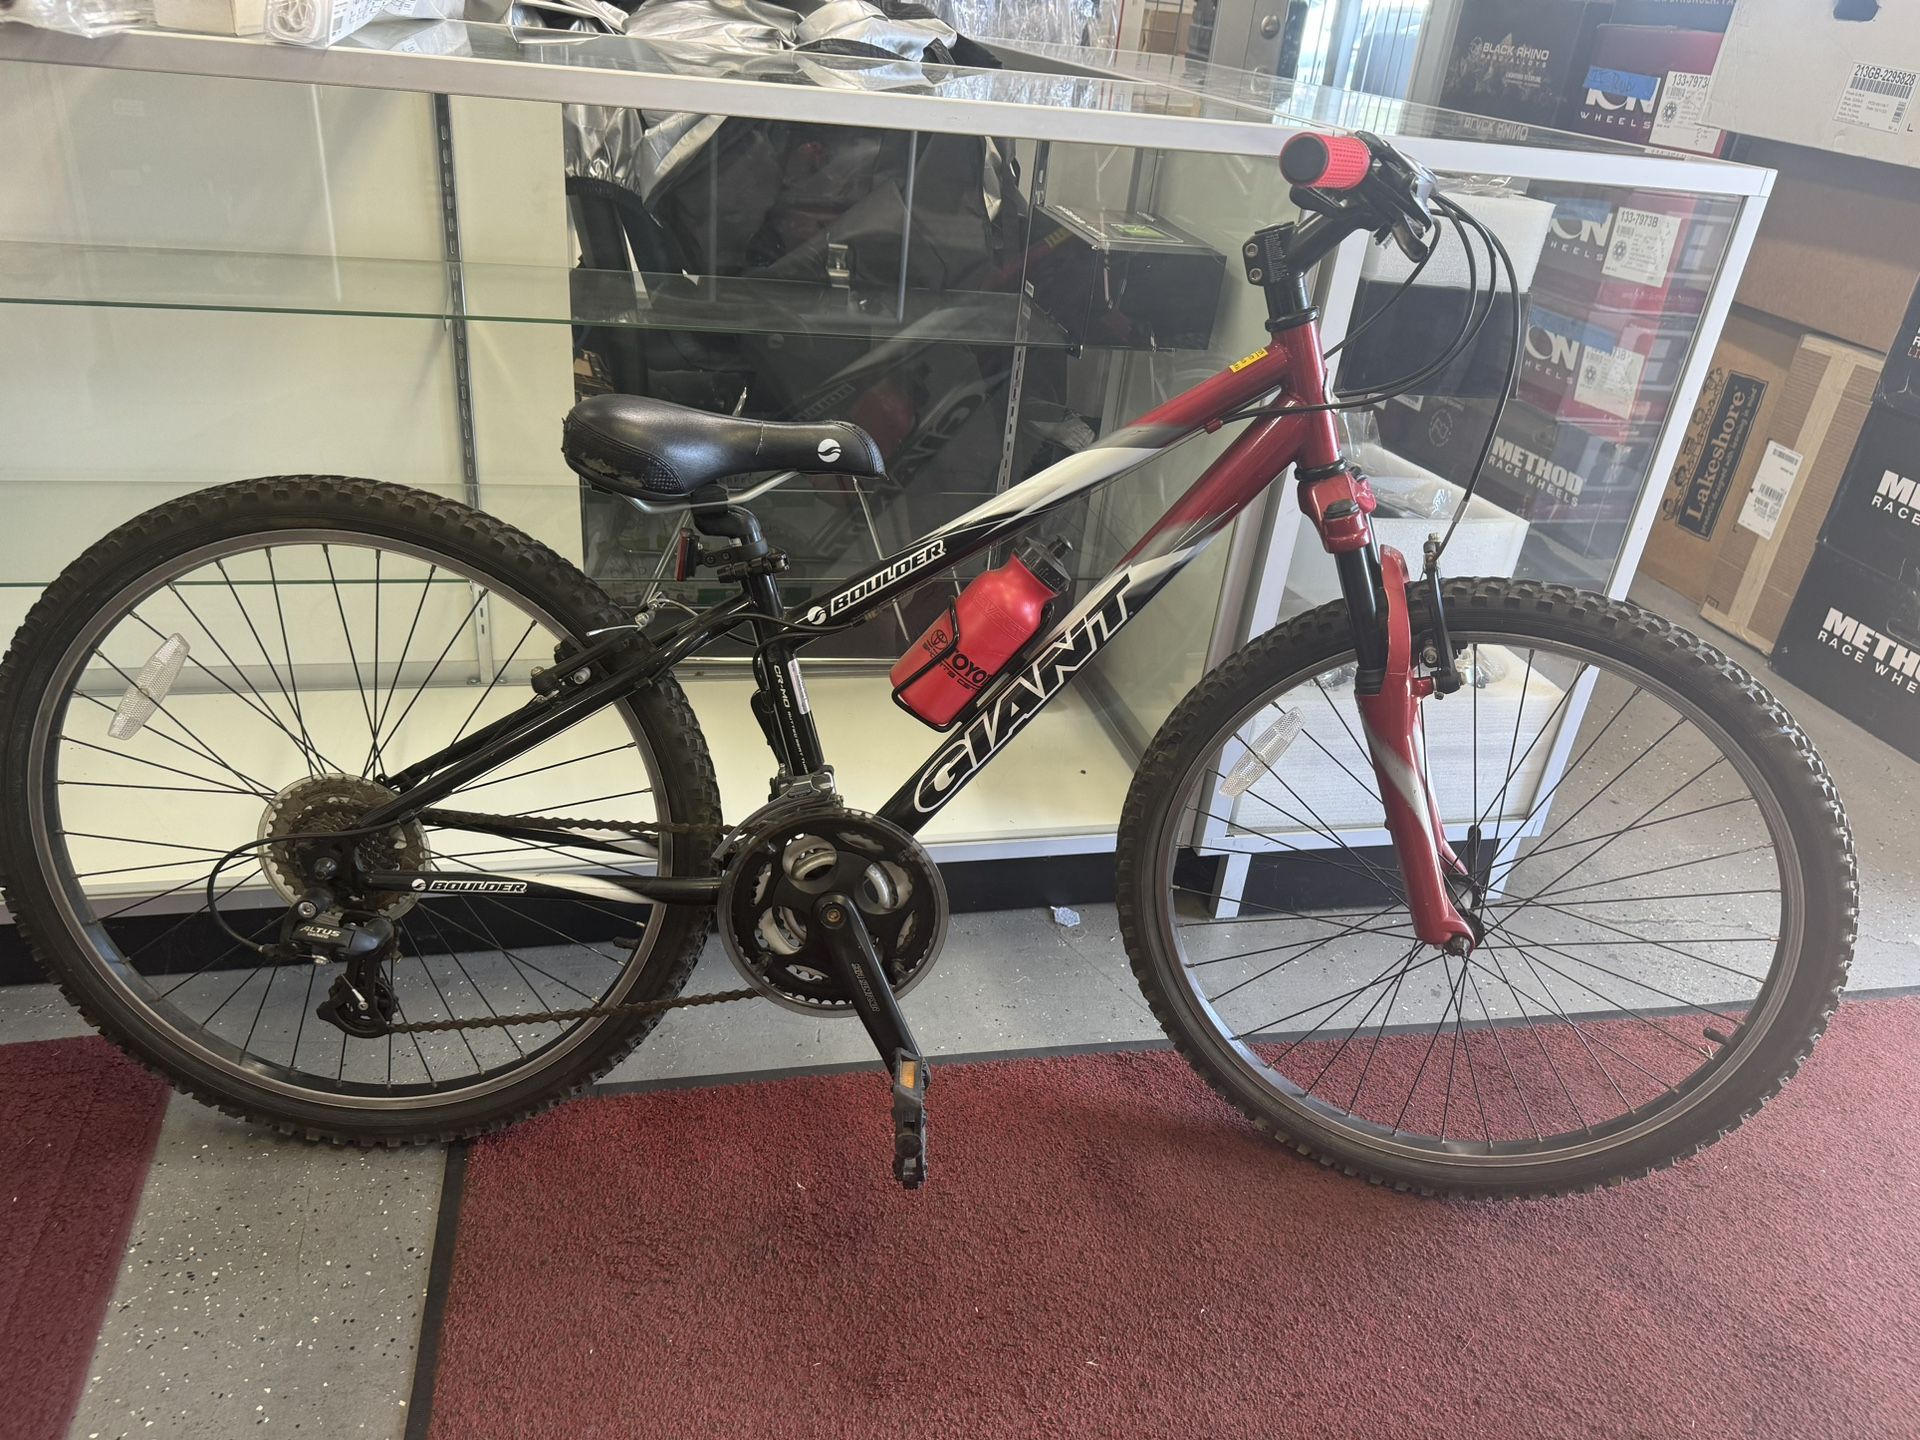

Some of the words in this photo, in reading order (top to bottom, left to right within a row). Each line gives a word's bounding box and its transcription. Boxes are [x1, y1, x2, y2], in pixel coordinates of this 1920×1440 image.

[1483, 42, 1514, 56] BLACK
[1516, 46, 1550, 61] RHINO
[1854, 65, 1916, 86] 213GB-2295828
[1579, 111, 1652, 129] WHEELS
[1620, 210, 1659, 227] 133-7973B
[1491, 436, 1584, 496] METHOD
[1686, 391, 1745, 520] Lakeshore
[1488, 456, 1522, 478] RACE
[1526, 474, 1579, 507] WHEELS
[1871, 495, 1920, 526] RACE
[831, 540, 946, 616] BOULDER
[1817, 630, 1864, 663] RACE
[1822, 607, 1920, 682] METH
[774, 664, 790, 708] CR-MO
[914, 572, 1134, 813] GIANT
[430, 880, 527, 894] BOULDER
[300, 926, 341, 937] ALTUS
